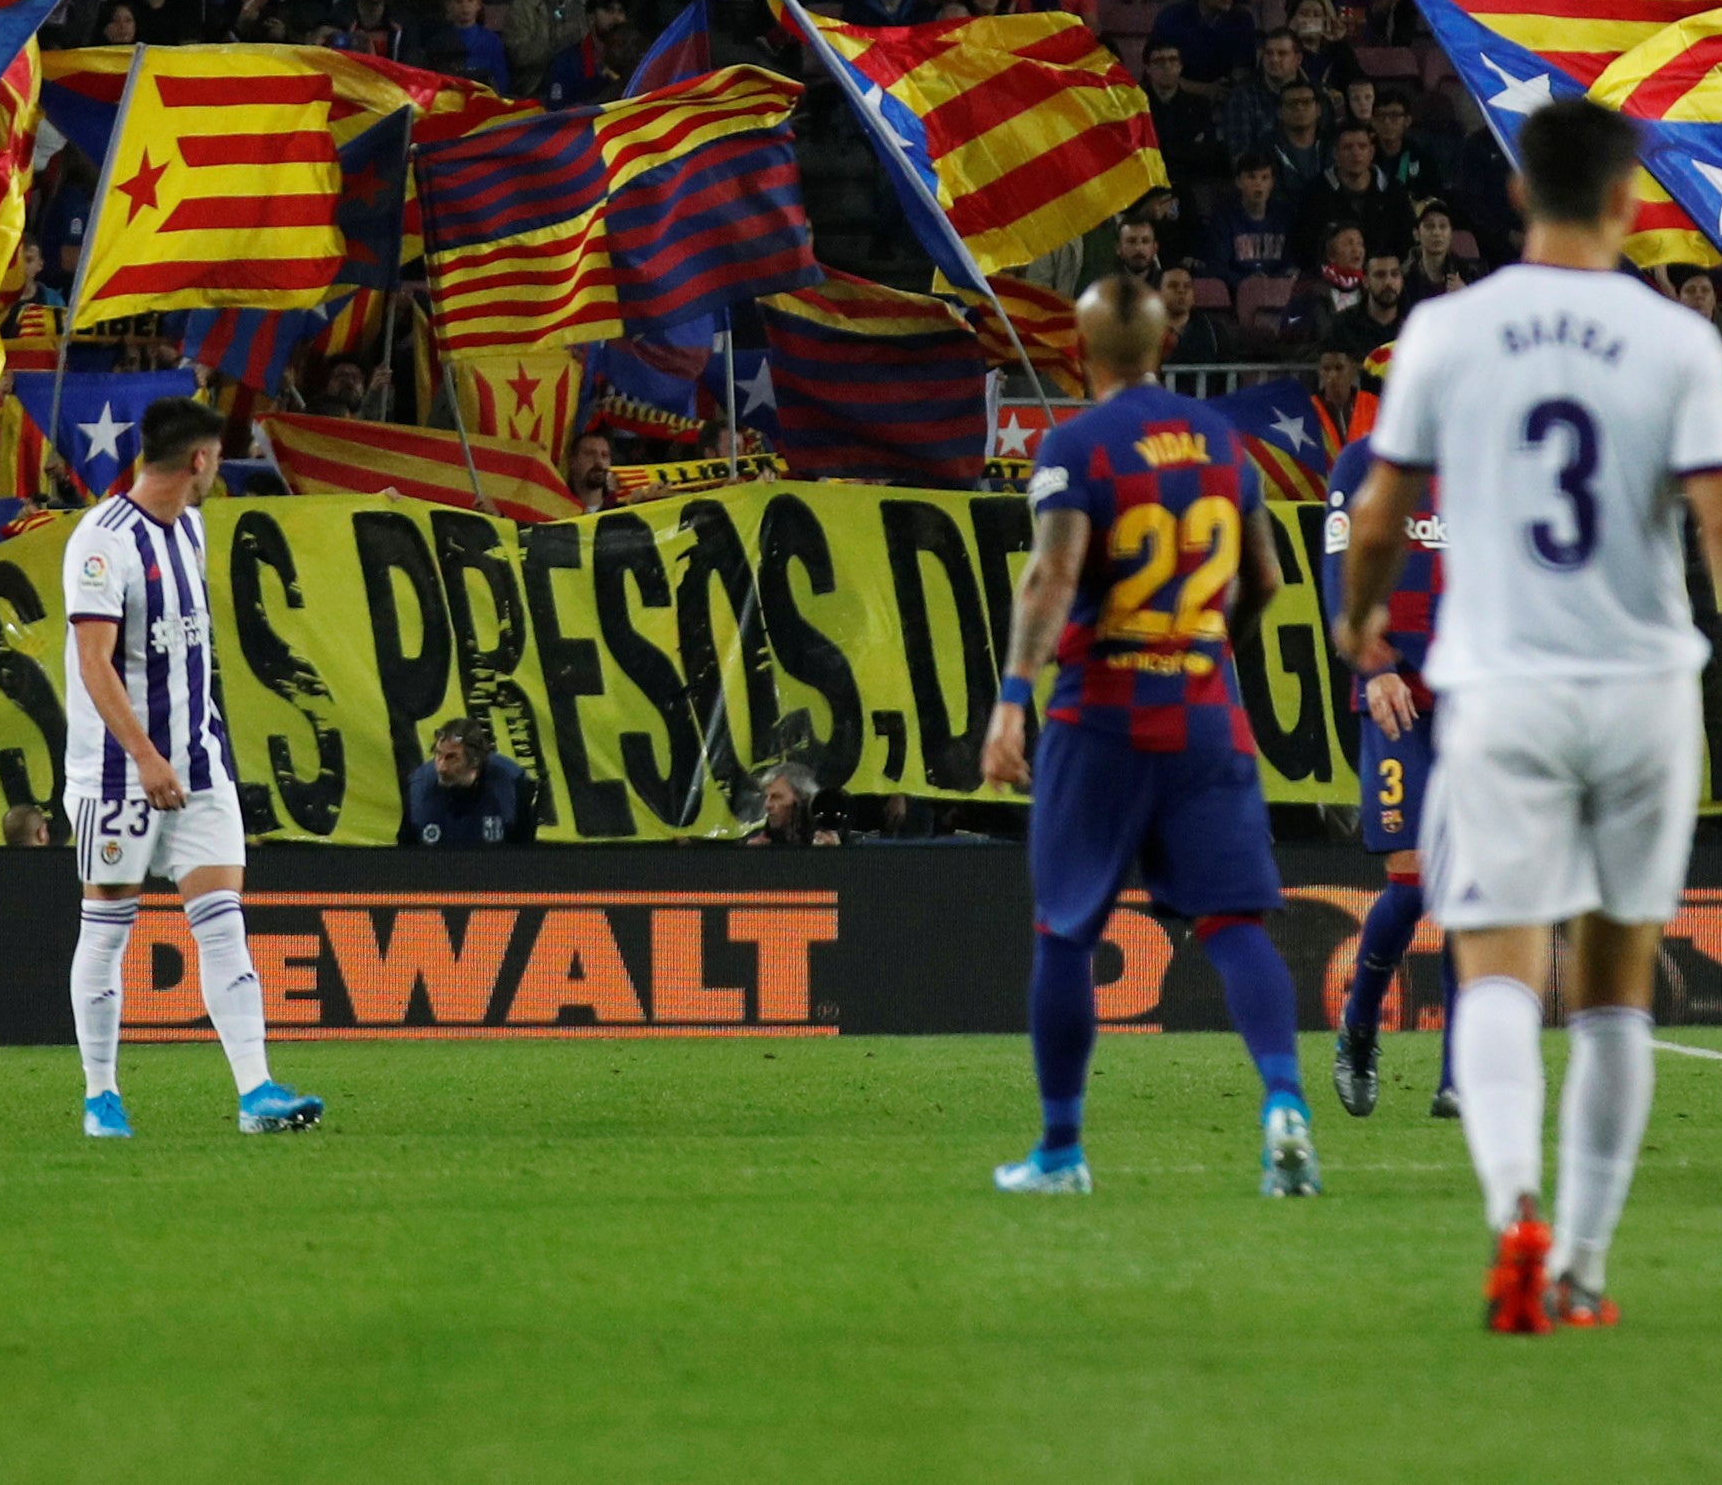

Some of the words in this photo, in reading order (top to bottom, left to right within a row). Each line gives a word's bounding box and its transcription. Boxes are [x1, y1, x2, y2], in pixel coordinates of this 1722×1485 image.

[1133, 431, 1212, 467] VIDAL
[1526, 398, 1599, 571] 3
[1095, 495, 1243, 642] 22
[1378, 757, 1404, 807] 3
[99, 798, 149, 837] 23
